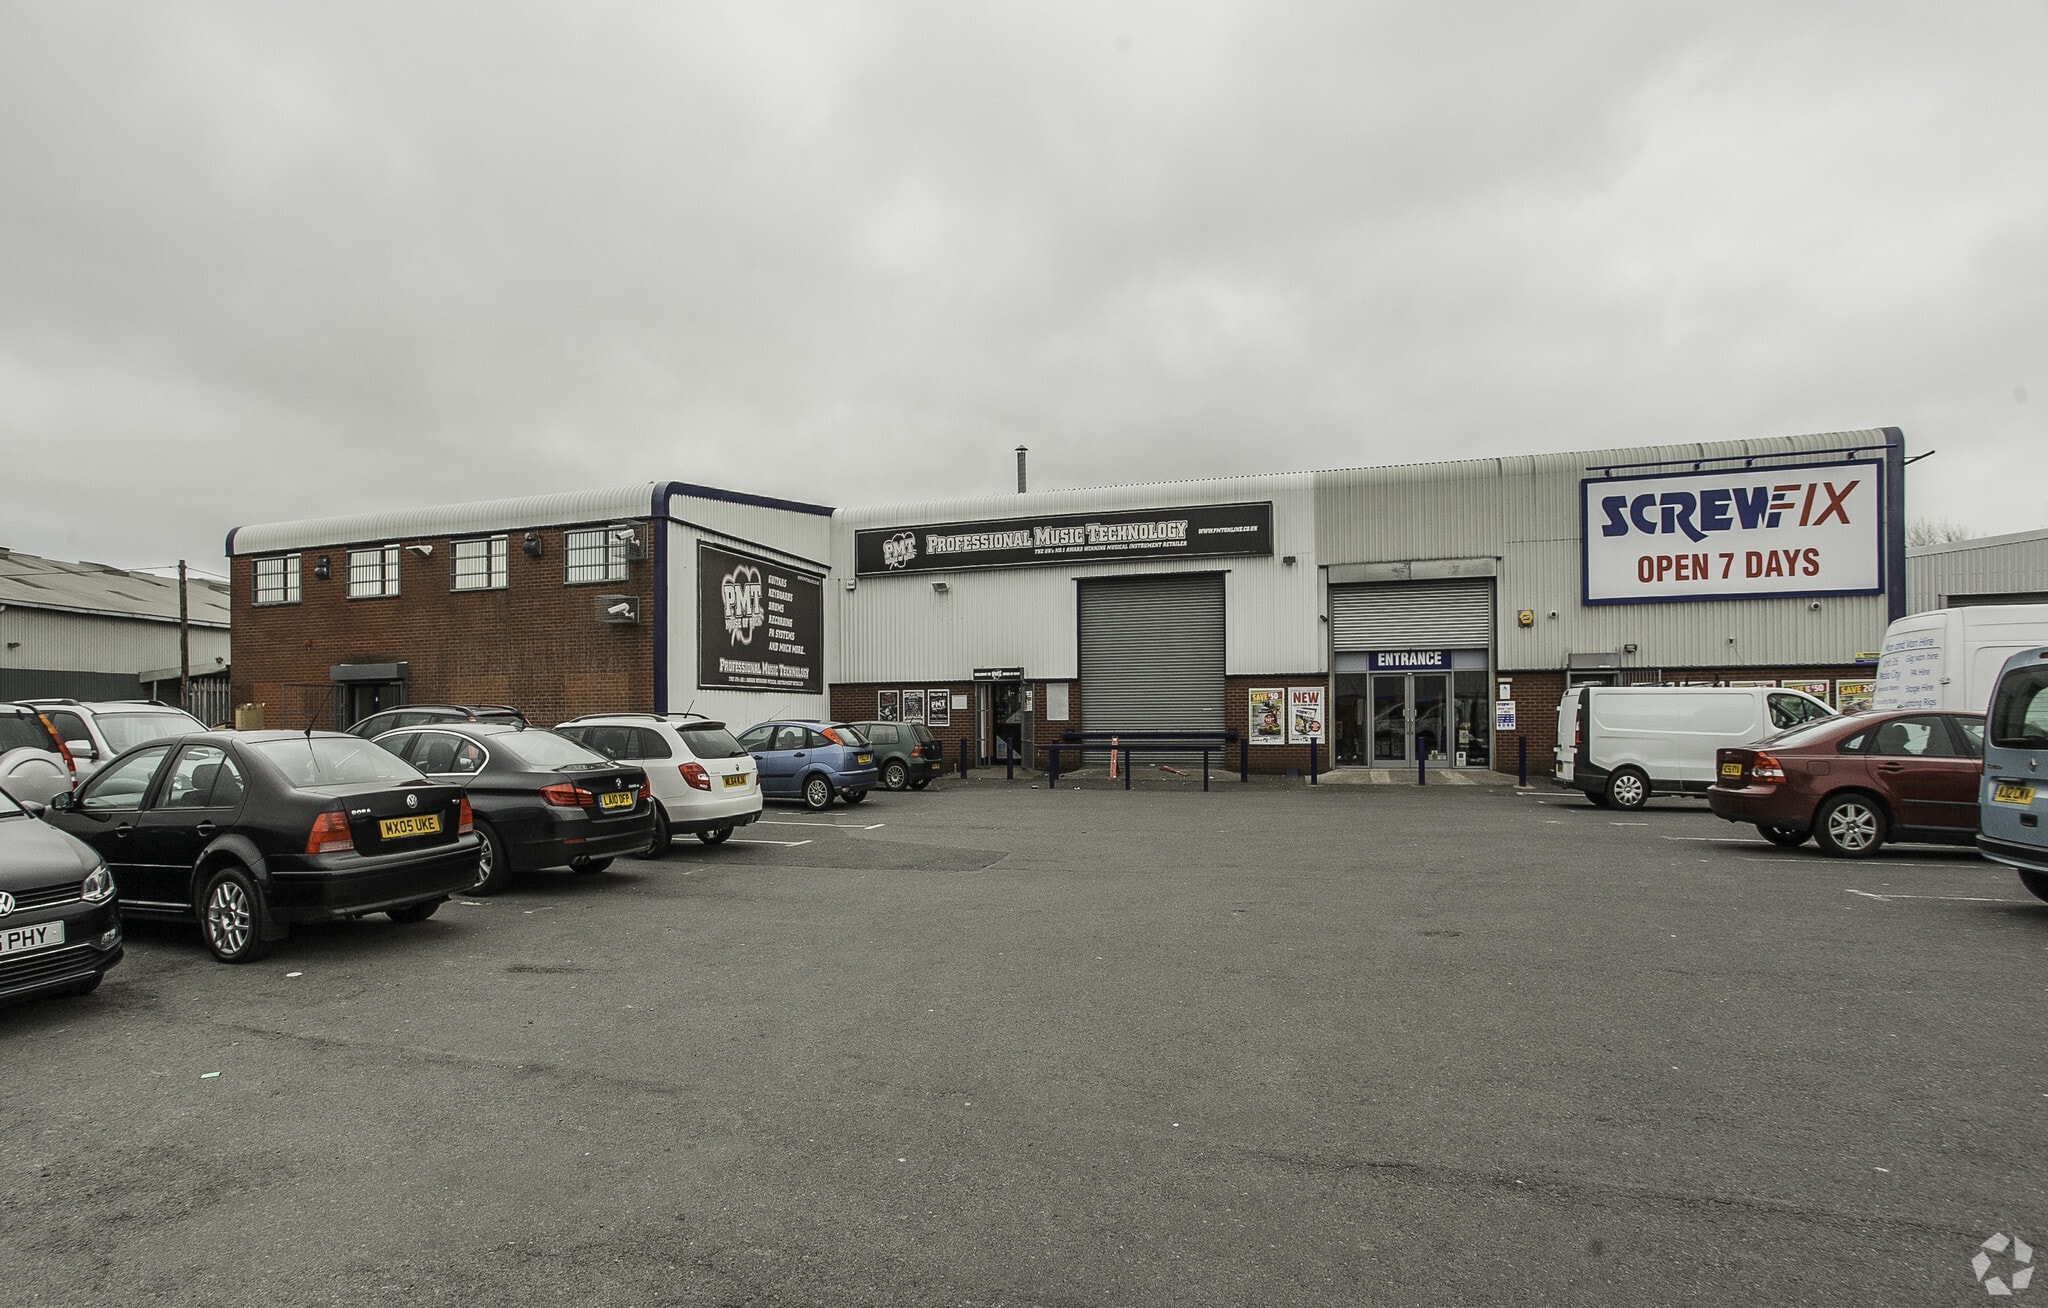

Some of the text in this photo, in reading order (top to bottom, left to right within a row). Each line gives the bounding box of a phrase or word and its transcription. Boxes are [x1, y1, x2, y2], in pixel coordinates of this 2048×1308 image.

[1602, 480, 1860, 542] SCREWFIX
[926, 520, 1188, 554] PROFESSIONAL MUSIC TECHNOLOGY
[884, 538, 916, 559] PMT
[1638, 548, 1820, 582] OPEN 7 DAYS
[768, 574, 787, 587] GUITARS
[724, 582, 762, 618] PMT
[768, 588, 793, 602] KEYBOARDS
[768, 601, 784, 613] DRUMS
[726, 619, 741, 629] HOUSE
[742, 618, 749, 628] OF
[768, 614, 793, 627] RECORDING
[768, 628, 795, 640] PA SYSTEMS
[769, 641, 778, 651] AND
[1378, 652, 1442, 666] ENTRANCE
[719, 657, 809, 679] PROFESSIONAL MUSIC TECHNOLOGY
[1840, 686, 1861, 694] SAVE
[931, 700, 946, 708] PMT
[1293, 692, 1319, 703] NEW
[620, 794, 629, 804] DFP
[386, 818, 435, 835] MX05 UKE
[8, 927, 47, 949] PHY
